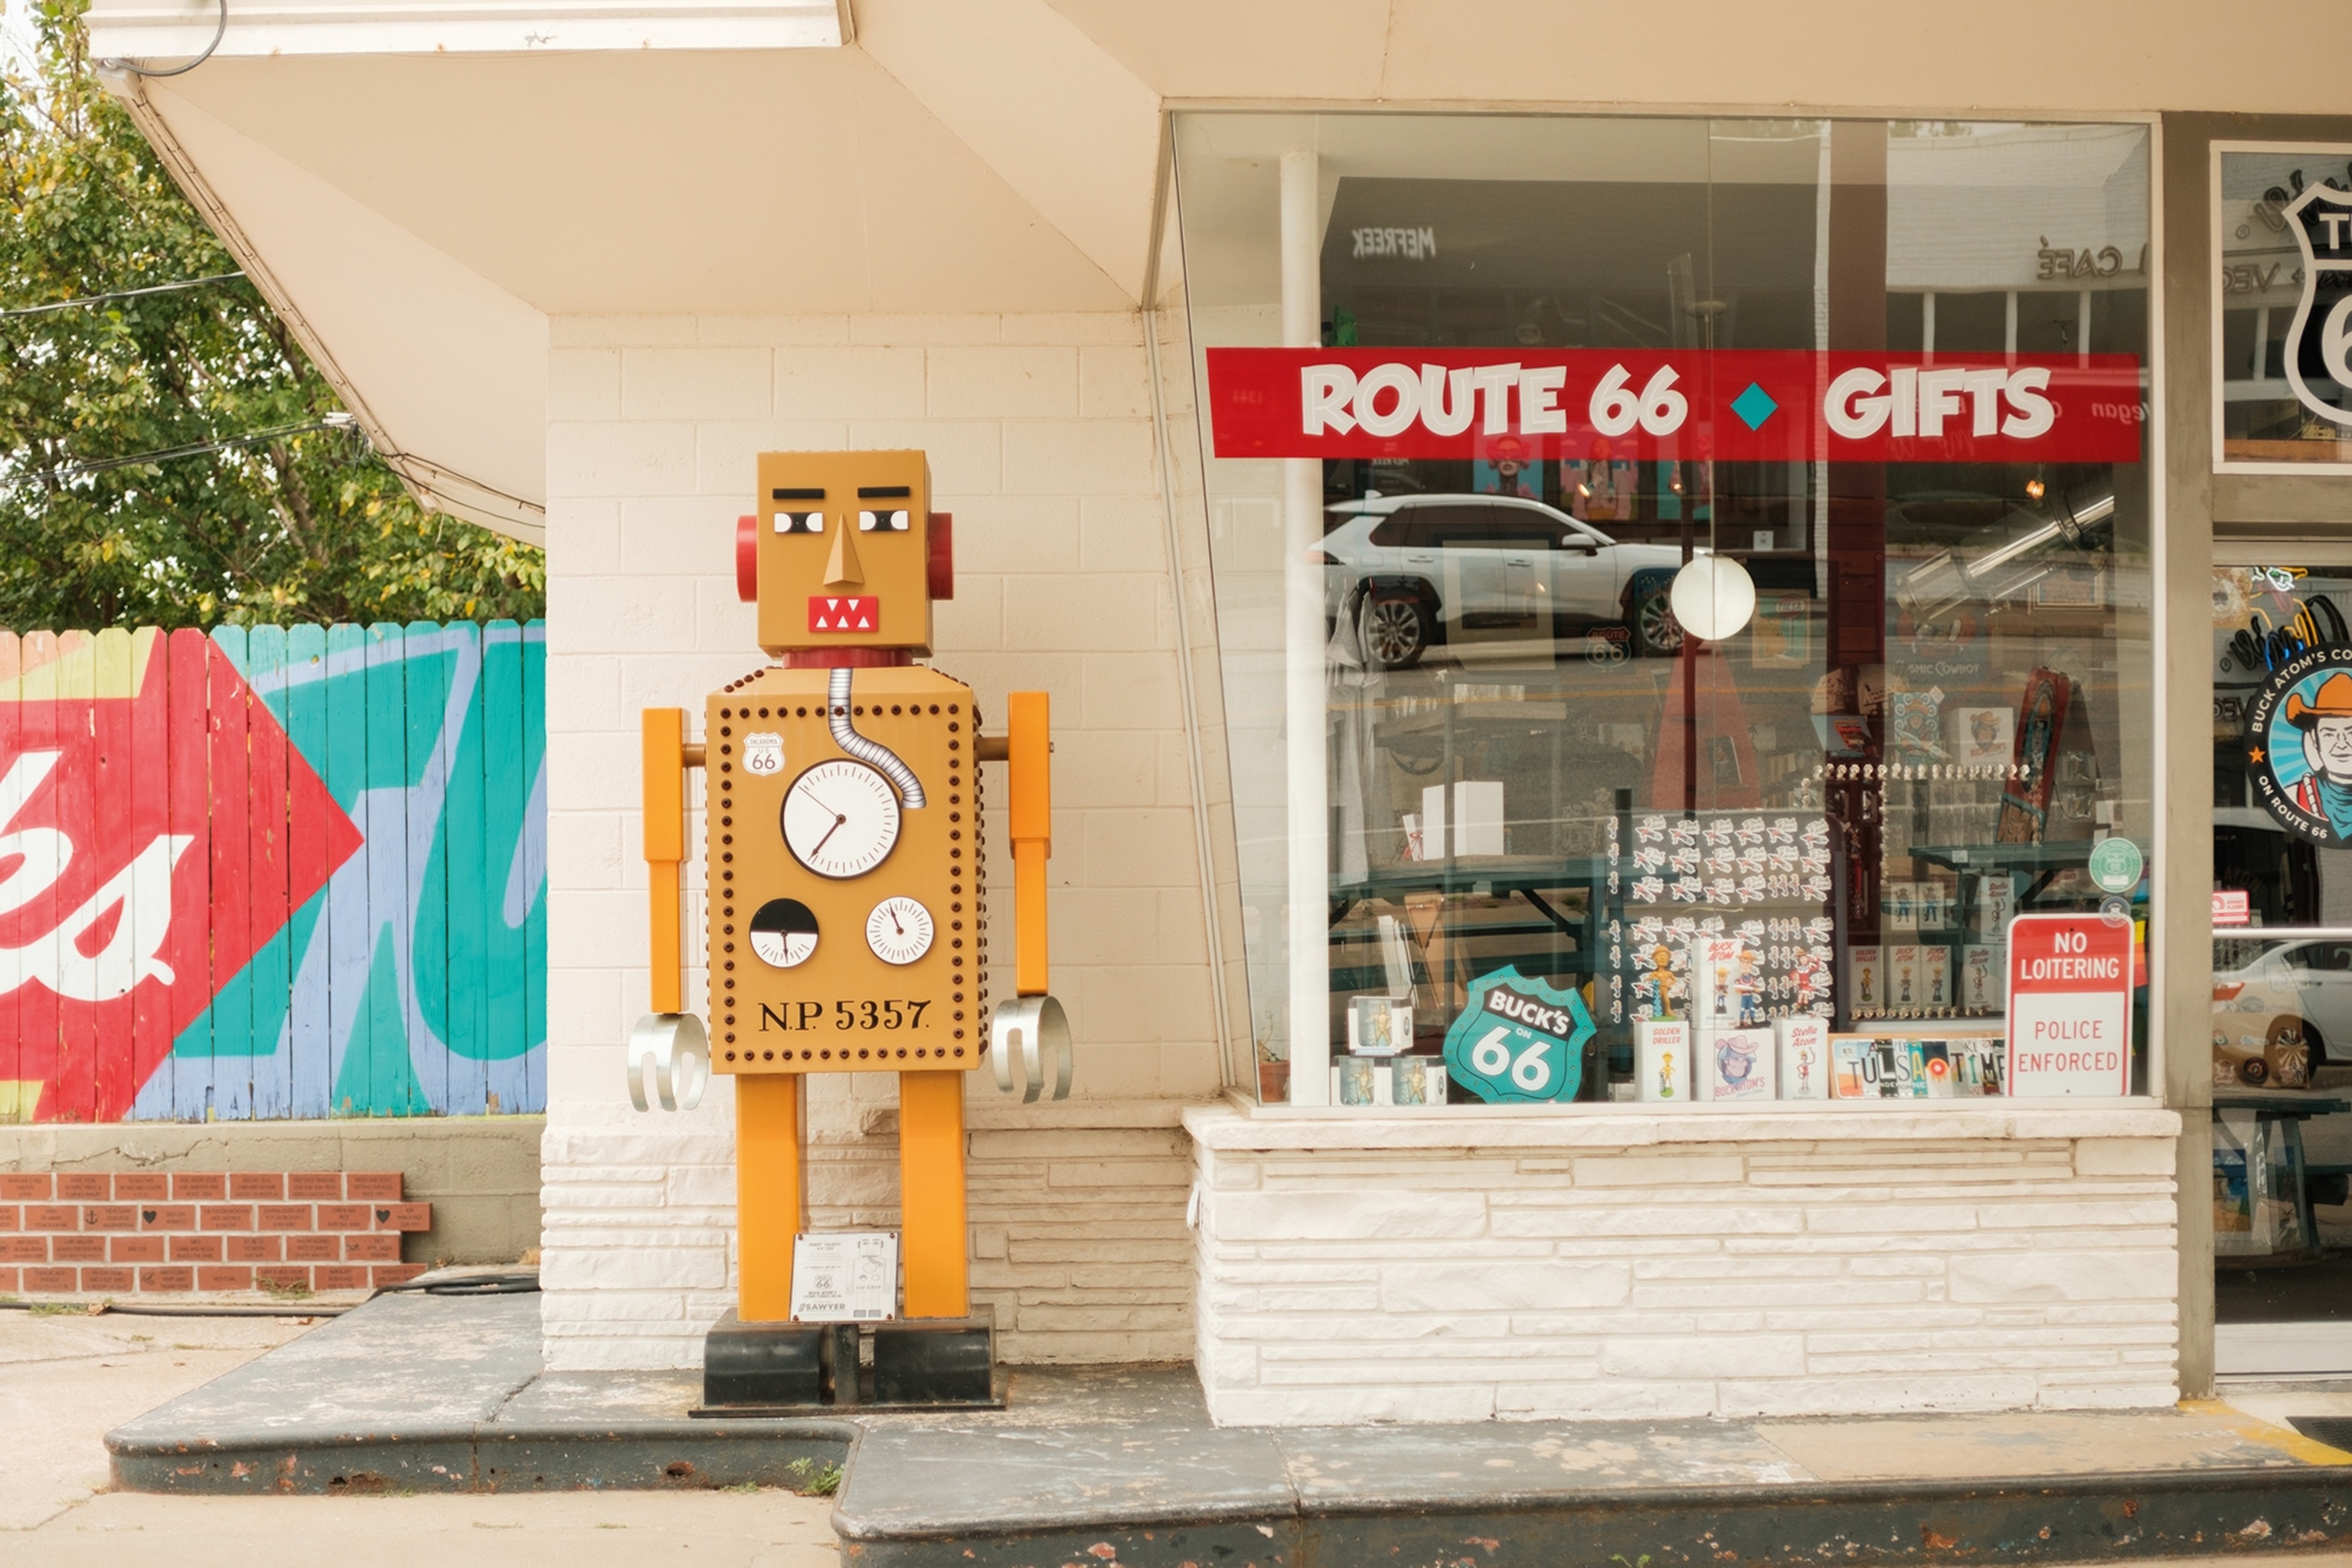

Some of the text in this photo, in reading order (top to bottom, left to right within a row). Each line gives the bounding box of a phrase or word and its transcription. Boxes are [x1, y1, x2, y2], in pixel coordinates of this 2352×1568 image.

[1300, 362, 2056, 439] ROUTE 66 GIFTS
[1592, 630, 1626, 640] ROUTE
[1592, 644, 1625, 662] 66
[2252, 688, 2277, 733] BUCK
[2274, 650, 2327, 689] ATOM'S
[752, 753, 776, 770] 66
[2259, 775, 2328, 840] ON ROUTE 66
[1988, 882, 2009, 891] Stella
[1708, 941, 1733, 952] BUCK
[2054, 931, 2087, 954] NO
[1707, 951, 1734, 962] ATOM
[1970, 949, 1989, 958] Stella
[2021, 957, 2119, 980] LOITERING
[757, 999, 932, 1032] N.P. 5357.
[1489, 990, 1570, 1035] BUCK'S
[1515, 1027, 1532, 1040] ON
[1652, 1027, 1681, 1036] GOLDEN
[1792, 1027, 1818, 1038] Stella
[2035, 1020, 2102, 1040] POLICE
[1652, 1036, 1681, 1045] DRILLER
[1792, 1037, 1817, 1047] Atom
[1472, 1025, 1553, 1092] 66
[2019, 1052, 2118, 1073] ENFORCED
[1847, 1050, 2004, 1089] TULSA TIME
[816, 1280, 830, 1289] 66
